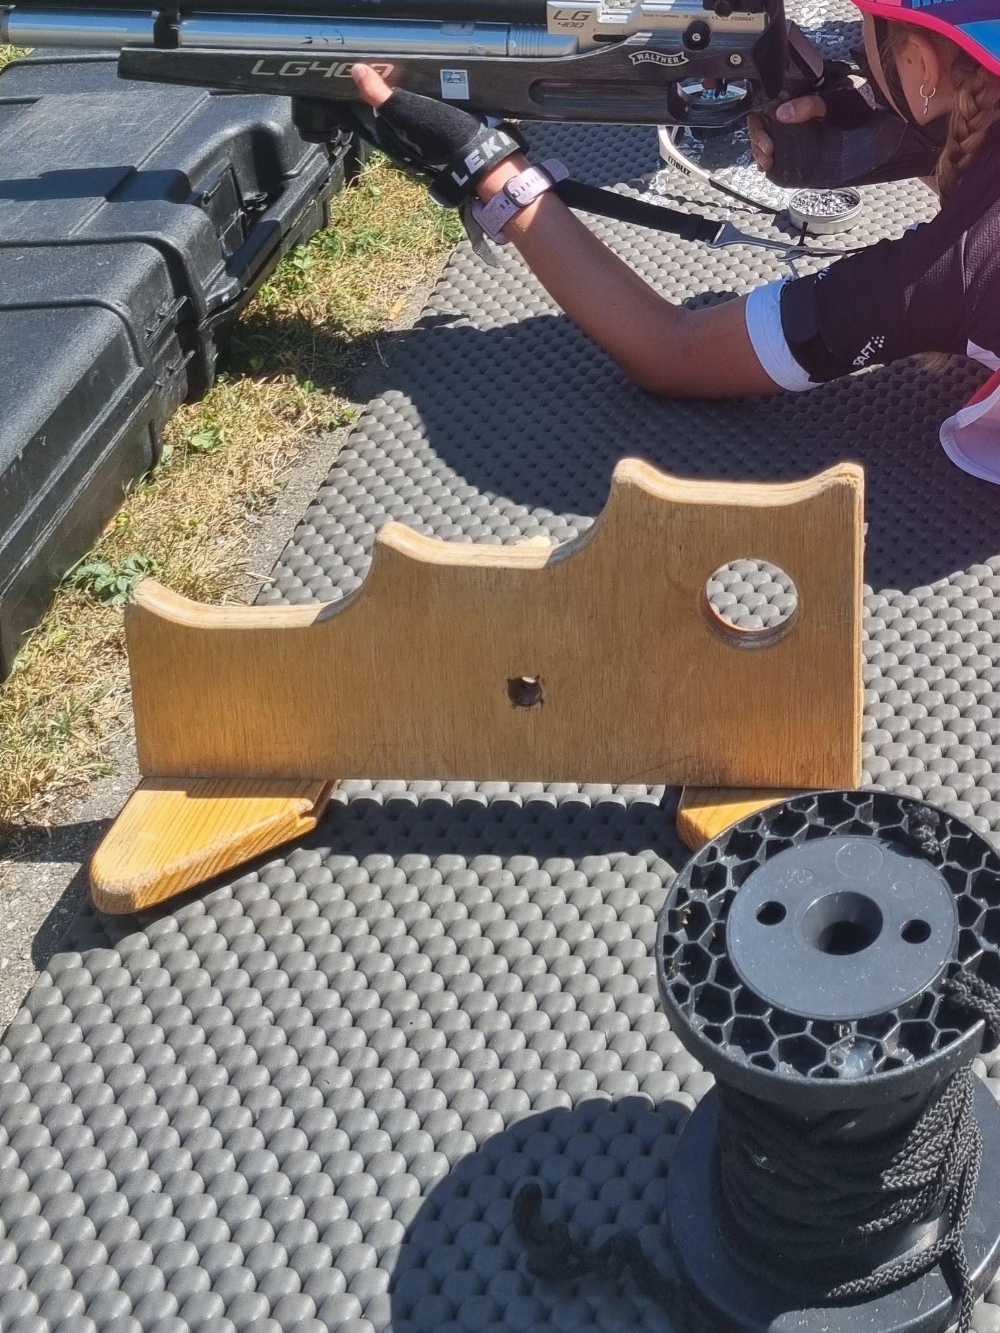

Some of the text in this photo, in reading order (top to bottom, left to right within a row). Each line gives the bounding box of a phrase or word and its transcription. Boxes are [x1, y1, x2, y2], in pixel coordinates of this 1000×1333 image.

[553, 10, 592, 21] LG
[557, 21, 585, 29] 400
[636, 54, 680, 64] WALTHER
[451, 131, 511, 186] LEKI
